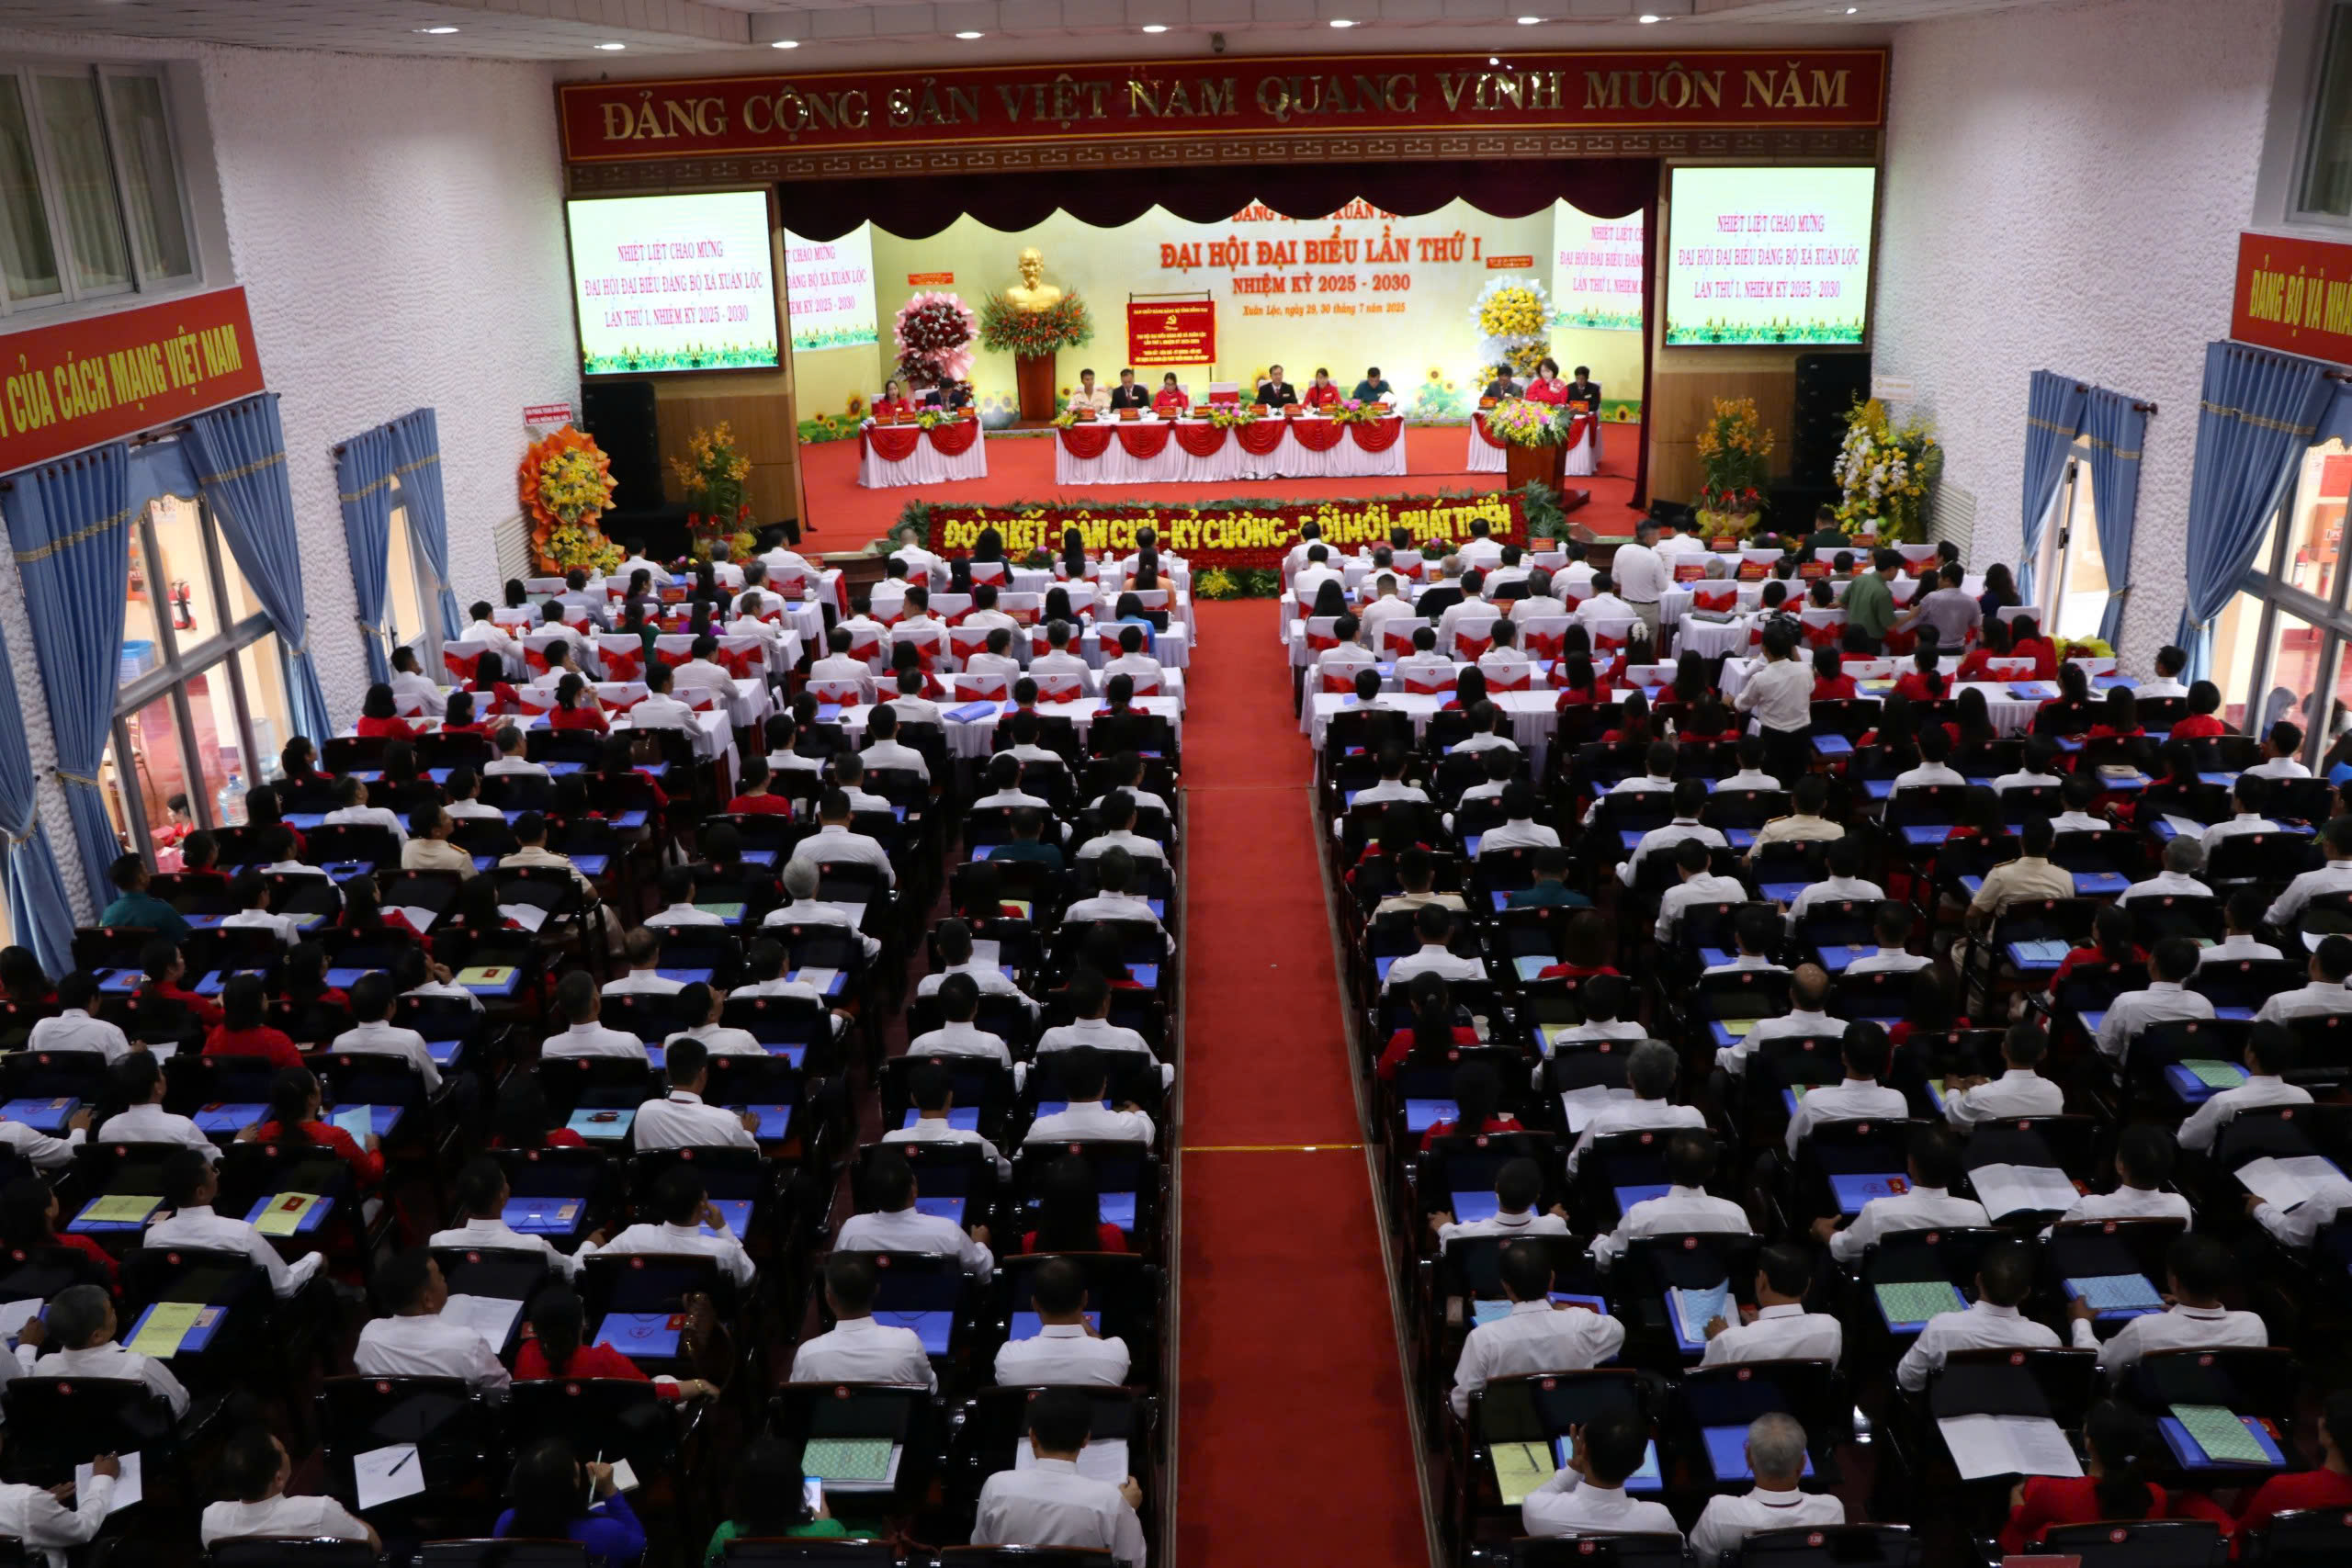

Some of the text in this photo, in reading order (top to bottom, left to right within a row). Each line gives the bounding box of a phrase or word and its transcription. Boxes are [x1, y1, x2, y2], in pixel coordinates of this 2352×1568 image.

[600, 90, 729, 140] ĐẢNG
[742, 85, 869, 141] CỘNG
[888, 76, 981, 128] SẢN
[996, 73, 1112, 130] VIỆT
[1125, 77, 1240, 118] NAM
[1256, 73, 1420, 123] QUANG
[1582, 61, 1726, 109] MUÔN
[1742, 61, 1851, 107] NĂM
[1160, 224, 1481, 274] ĐẠI HỘI ĐẠI BIỂU LẦN THỨ I
[1232, 272, 1286, 298] NHIỆM
[1291, 271, 1314, 293] KỲ
[1318, 274, 1357, 292] 2025
[1373, 274, 1411, 291] 2030
[1790, 280, 1811, 299] 2025
[1819, 280, 1840, 299] 2030
[2249, 254, 2285, 322] ĐẢNG
[2283, 265, 2305, 337] BỘ
[698, 306, 720, 323] 2025
[728, 304, 749, 322] 2030
[6, 353, 56, 434] CỦA
[53, 351, 112, 421] CÁCH
[108, 343, 168, 412] MẠNG
[163, 325, 204, 395] VIỆT
[200, 323, 243, 378] NAM
